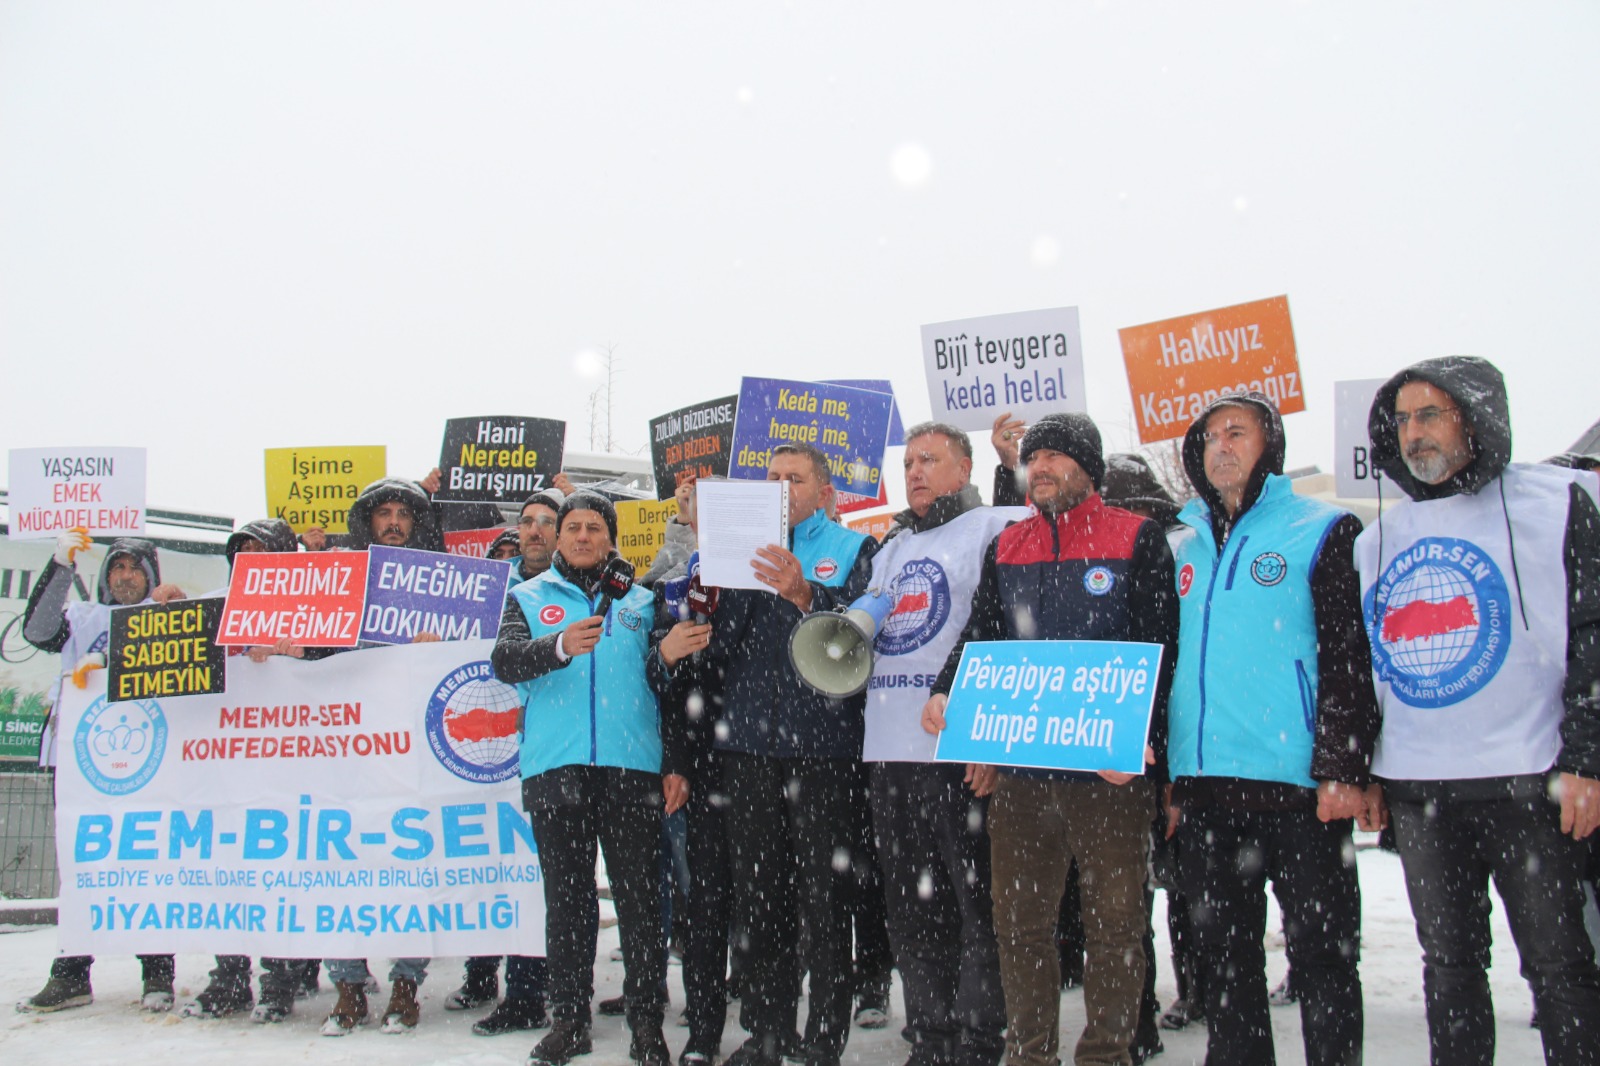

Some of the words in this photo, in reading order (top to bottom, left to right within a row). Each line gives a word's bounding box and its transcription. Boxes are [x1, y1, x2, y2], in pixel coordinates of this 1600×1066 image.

[934, 334, 968, 376] Bijî
[975, 332, 1068, 370] tevgera
[1159, 323, 1263, 368] Haklıyız
[777, 389, 818, 413] Keda
[821, 398, 850, 421] me,
[943, 377, 996, 411] keda
[1004, 367, 1067, 406] helal
[477, 421, 525, 444] Hani
[655, 416, 681, 442] ZULÜM
[683, 404, 732, 432] BİZDENSE
[666, 444, 682, 465] BEN
[684, 435, 720, 460] BİZDEN
[822, 428, 850, 451] me,
[42, 457, 114, 482] YAŞASIN
[292, 453, 353, 480] İşime
[460, 444, 538, 468] Nerede
[738, 445, 772, 468] dest
[53, 483, 102, 503] EMEK
[288, 481, 358, 505] Aşıma
[450, 466, 545, 497] Barışınız
[18, 506, 140, 532] MÜCADELEMİZ
[622, 528, 653, 547] nanê
[244, 559, 353, 596] DERDİMİZ
[378, 561, 491, 602] EMEĞİME
[1377, 544, 1491, 603] MEMUR-SEN
[127, 603, 203, 638] SÜRECİ
[225, 604, 356, 639] EKMEĞİMİZ
[364, 604, 482, 640] DOKUNMA
[122, 637, 207, 669] SABOTE
[1436, 599, 1500, 698] KONFEDERASYONU
[119, 666, 210, 698] ETMEYİN
[961, 654, 1066, 700] Pêvajoya
[1072, 656, 1148, 703] aştîyê
[1417, 679, 1439, 688] 1995
[219, 702, 361, 729] MEMUR-SEN
[970, 703, 1039, 753] binpê
[1044, 708, 1114, 748] nekin
[182, 731, 411, 761] KONFEDERASYONU
[75, 794, 539, 863] BEM-BİR-SEN
[154, 873, 174, 886] ve
[178, 867, 213, 887] ÖZEL
[214, 866, 256, 887] İDARE
[262, 868, 373, 892] ÇALIŞANLARI
[378, 866, 439, 888] BİRLİĞİ
[445, 862, 541, 886] SENDİKASI
[90, 896, 267, 932] DİYARBAKIR
[276, 896, 306, 932] İL
